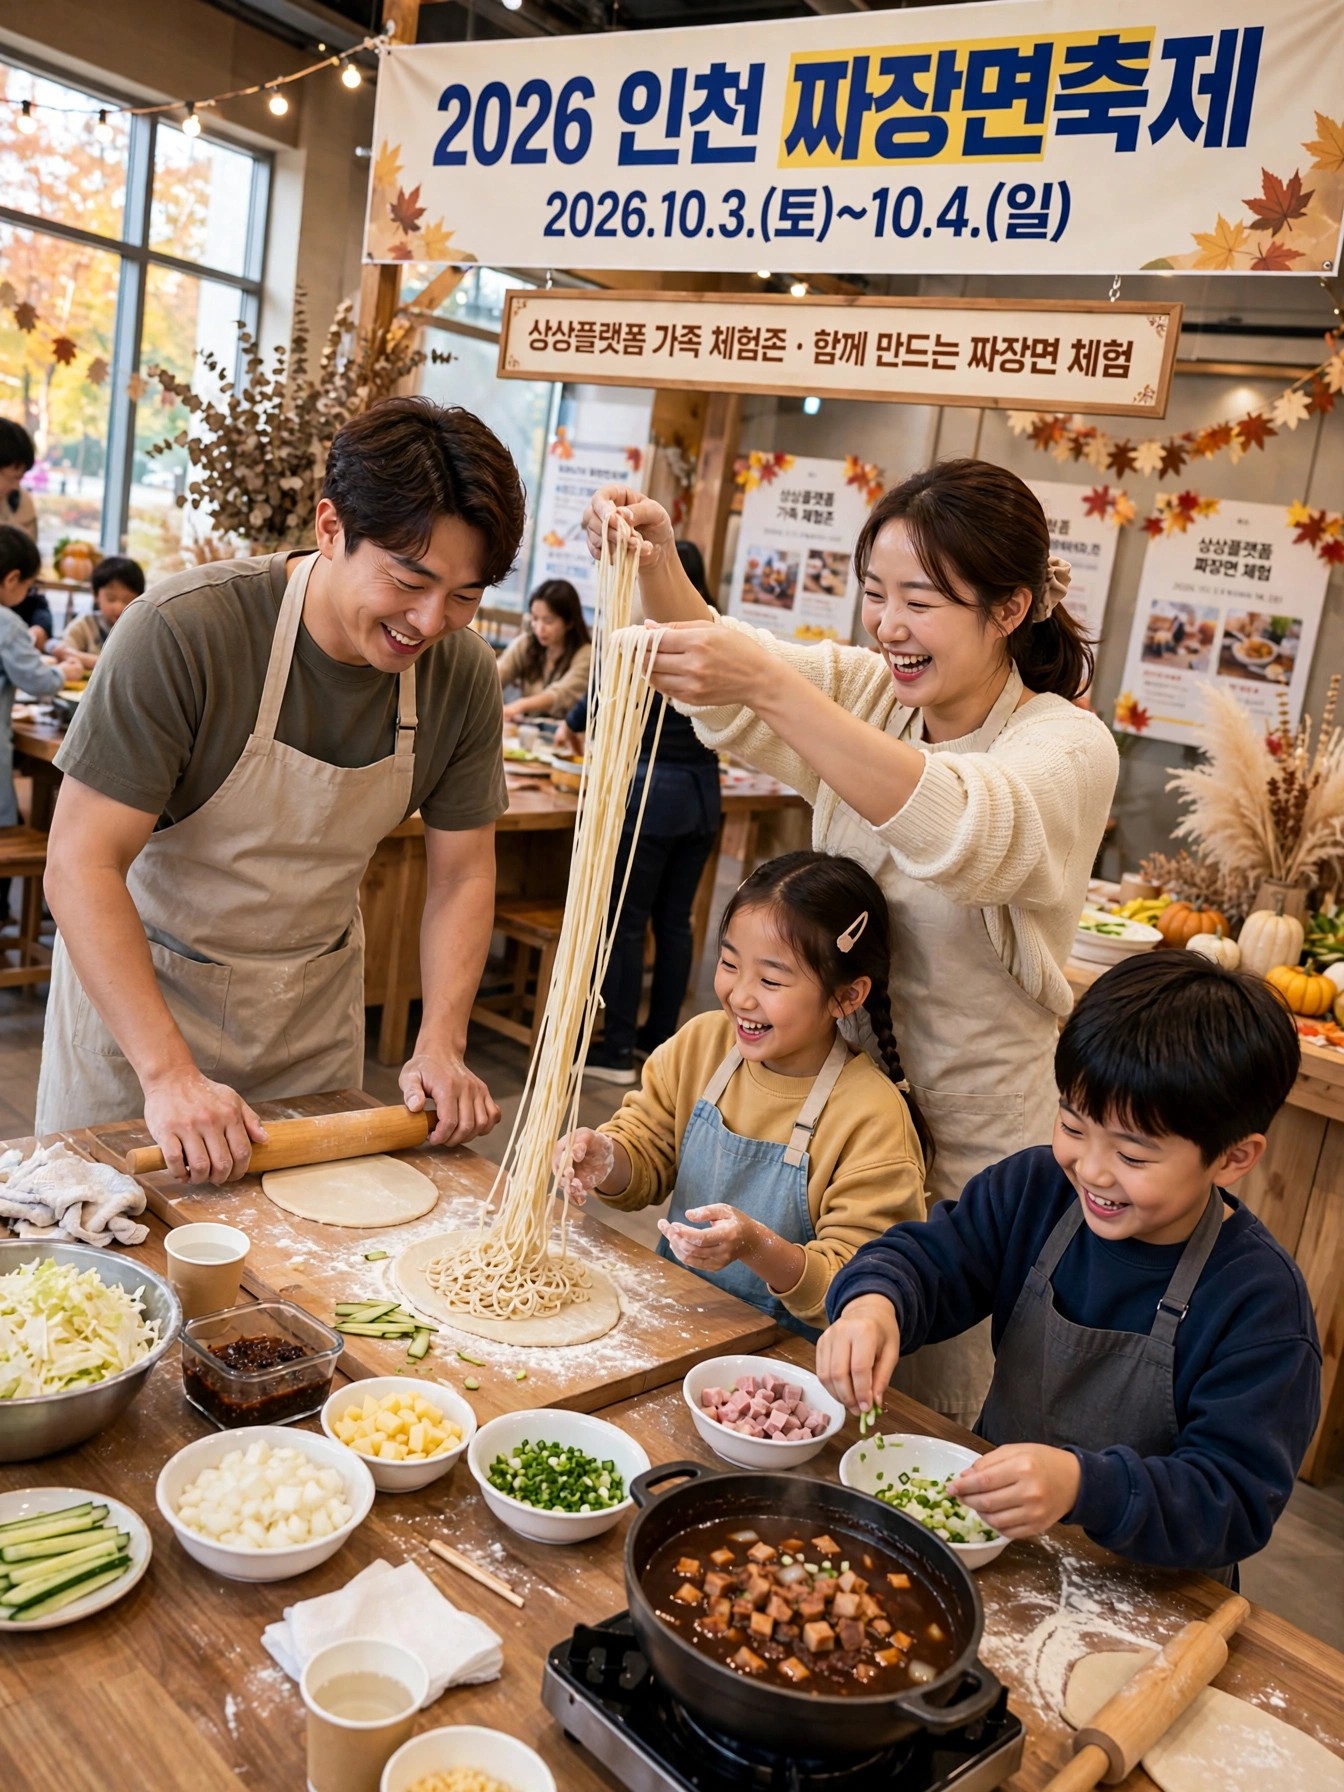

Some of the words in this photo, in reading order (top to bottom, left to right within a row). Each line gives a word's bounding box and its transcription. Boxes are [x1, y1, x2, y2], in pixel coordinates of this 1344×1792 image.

[433, 77, 595, 166] 2026
[618, 63, 766, 165] 인천
[786, 27, 1263, 159] 짜장면축제
[544, 181, 1071, 242] 2026.10.3.(토)~10.4.(일)
[528, 319, 647, 356] 상상플랫폼
[652, 324, 702, 358] 가족
[709, 325, 787, 363] 체험존
[813, 329, 868, 366] 함께
[876, 332, 960, 371] 만드는
[967, 336, 1060, 375] 짜장면
[1067, 338, 1134, 379] 체험
